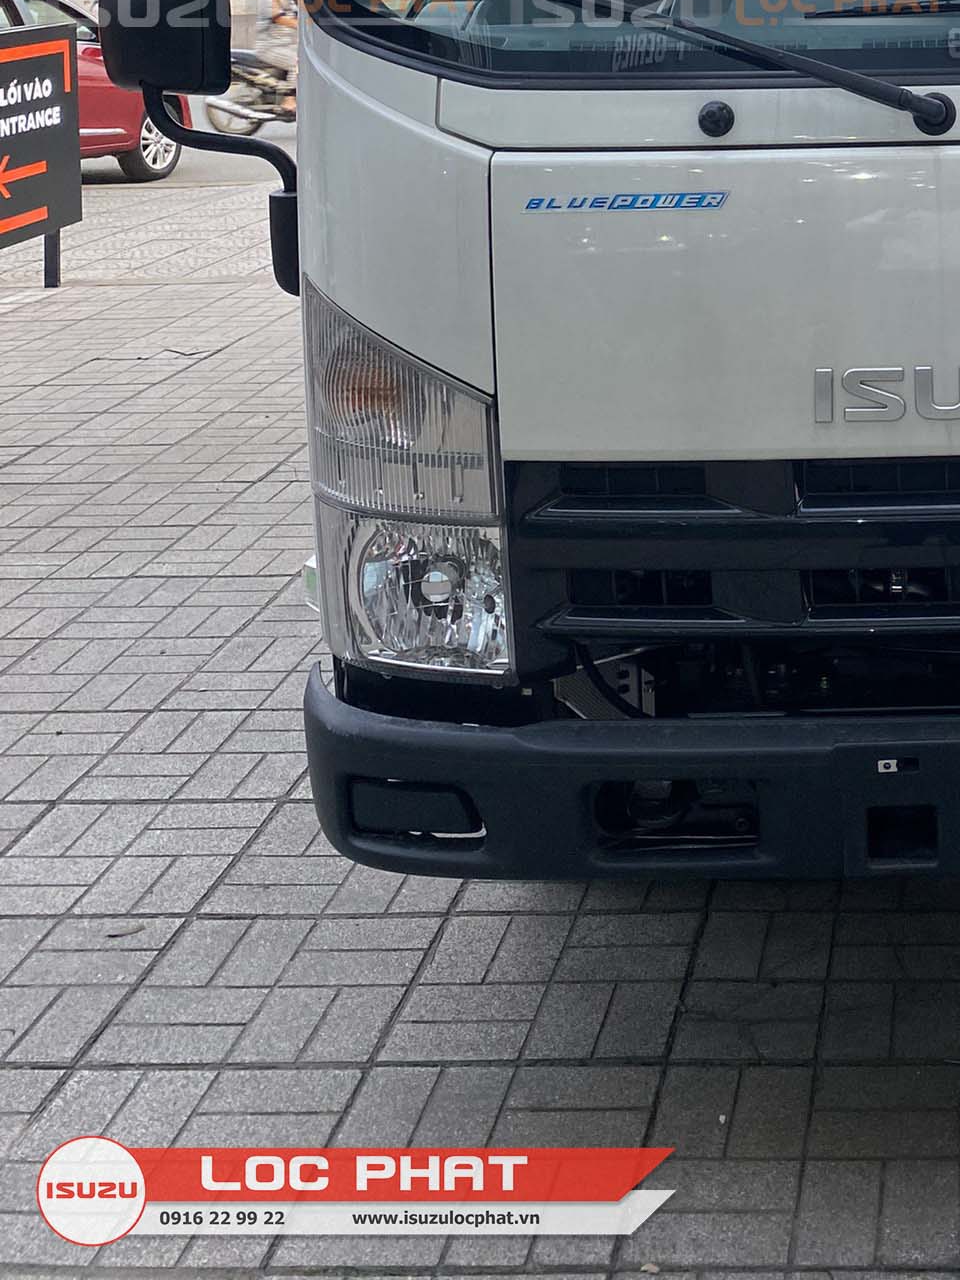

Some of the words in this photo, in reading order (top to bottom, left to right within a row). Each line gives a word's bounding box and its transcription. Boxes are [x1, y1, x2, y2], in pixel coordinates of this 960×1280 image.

[0, 79, 22, 107] LỐI
[23, 77, 52, 102] VÀO
[0, 106, 61, 138] NTRANCE
